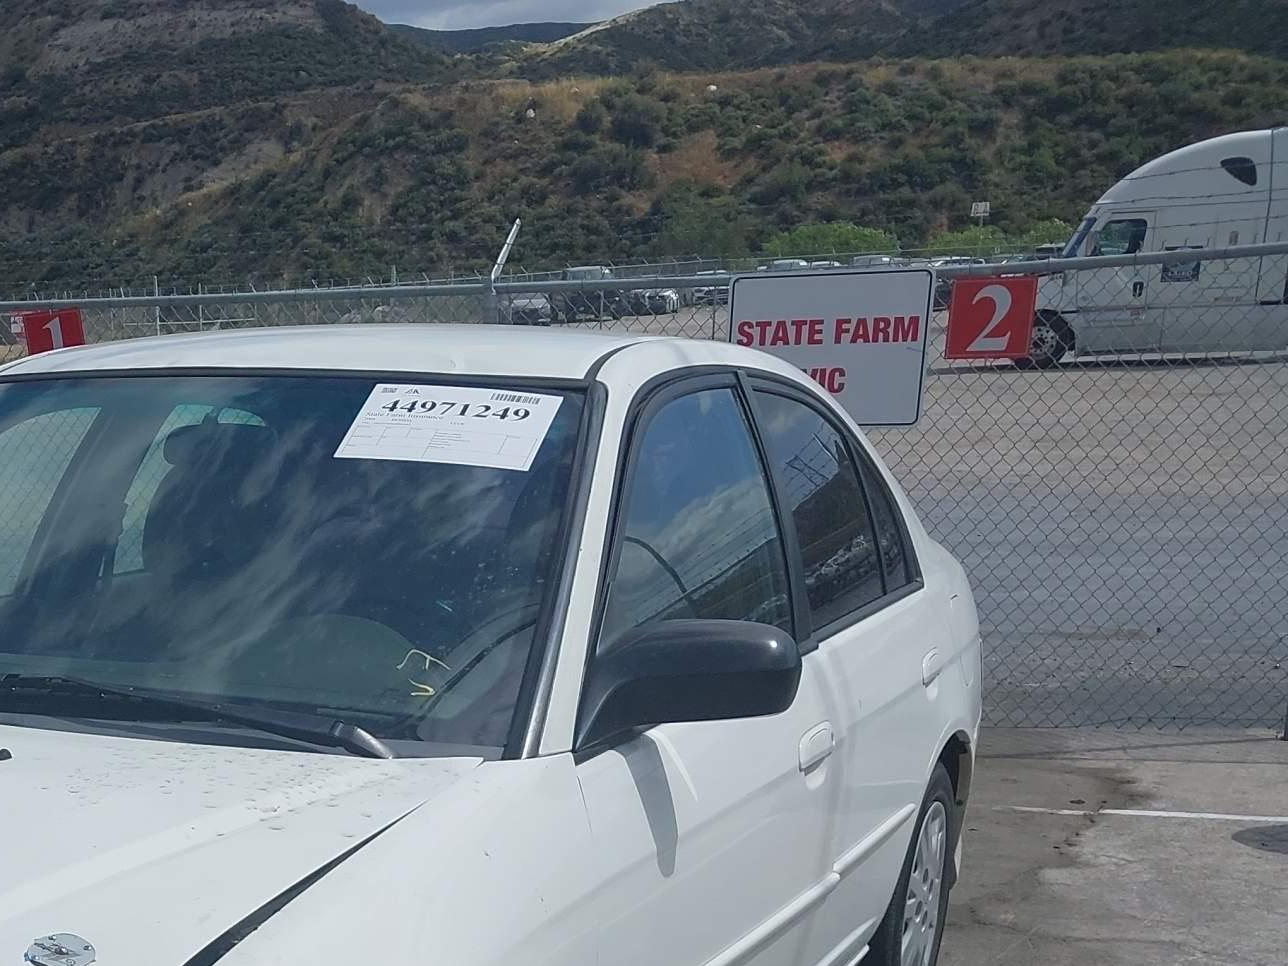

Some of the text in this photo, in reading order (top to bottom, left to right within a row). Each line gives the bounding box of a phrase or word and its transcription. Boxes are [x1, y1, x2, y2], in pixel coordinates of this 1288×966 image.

[41, 316, 64, 350] 1
[736, 315, 921, 348] STATE FARM
[965, 284, 1013, 352] 2
[381, 399, 531, 422] 44971249
